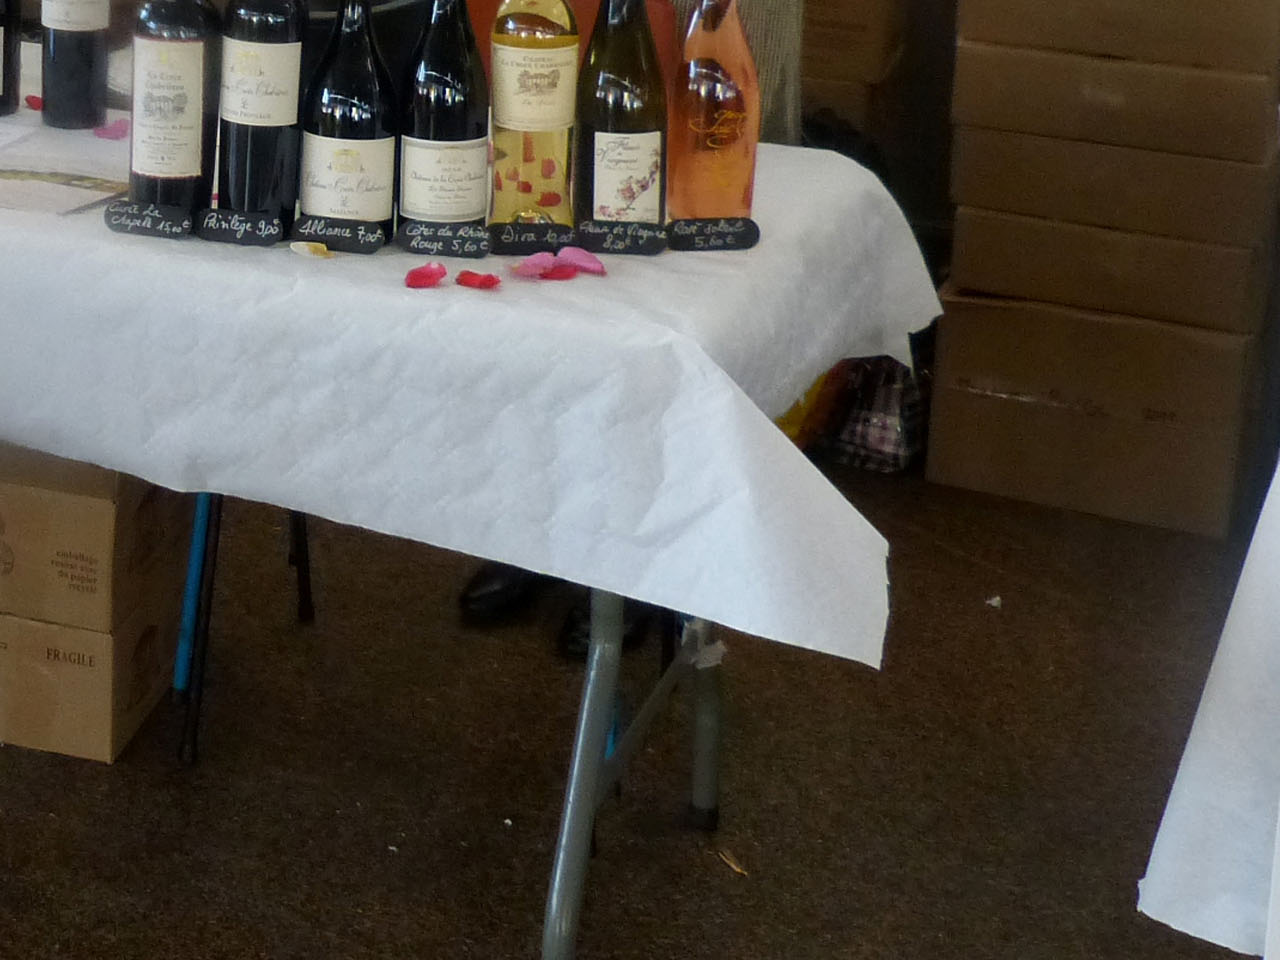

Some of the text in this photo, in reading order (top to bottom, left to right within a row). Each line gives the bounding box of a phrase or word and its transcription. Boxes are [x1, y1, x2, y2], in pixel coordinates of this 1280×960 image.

[437, 225, 453, 237] du
[409, 236, 444, 255] Rouge
[46, 647, 96, 668] FRAGILE
